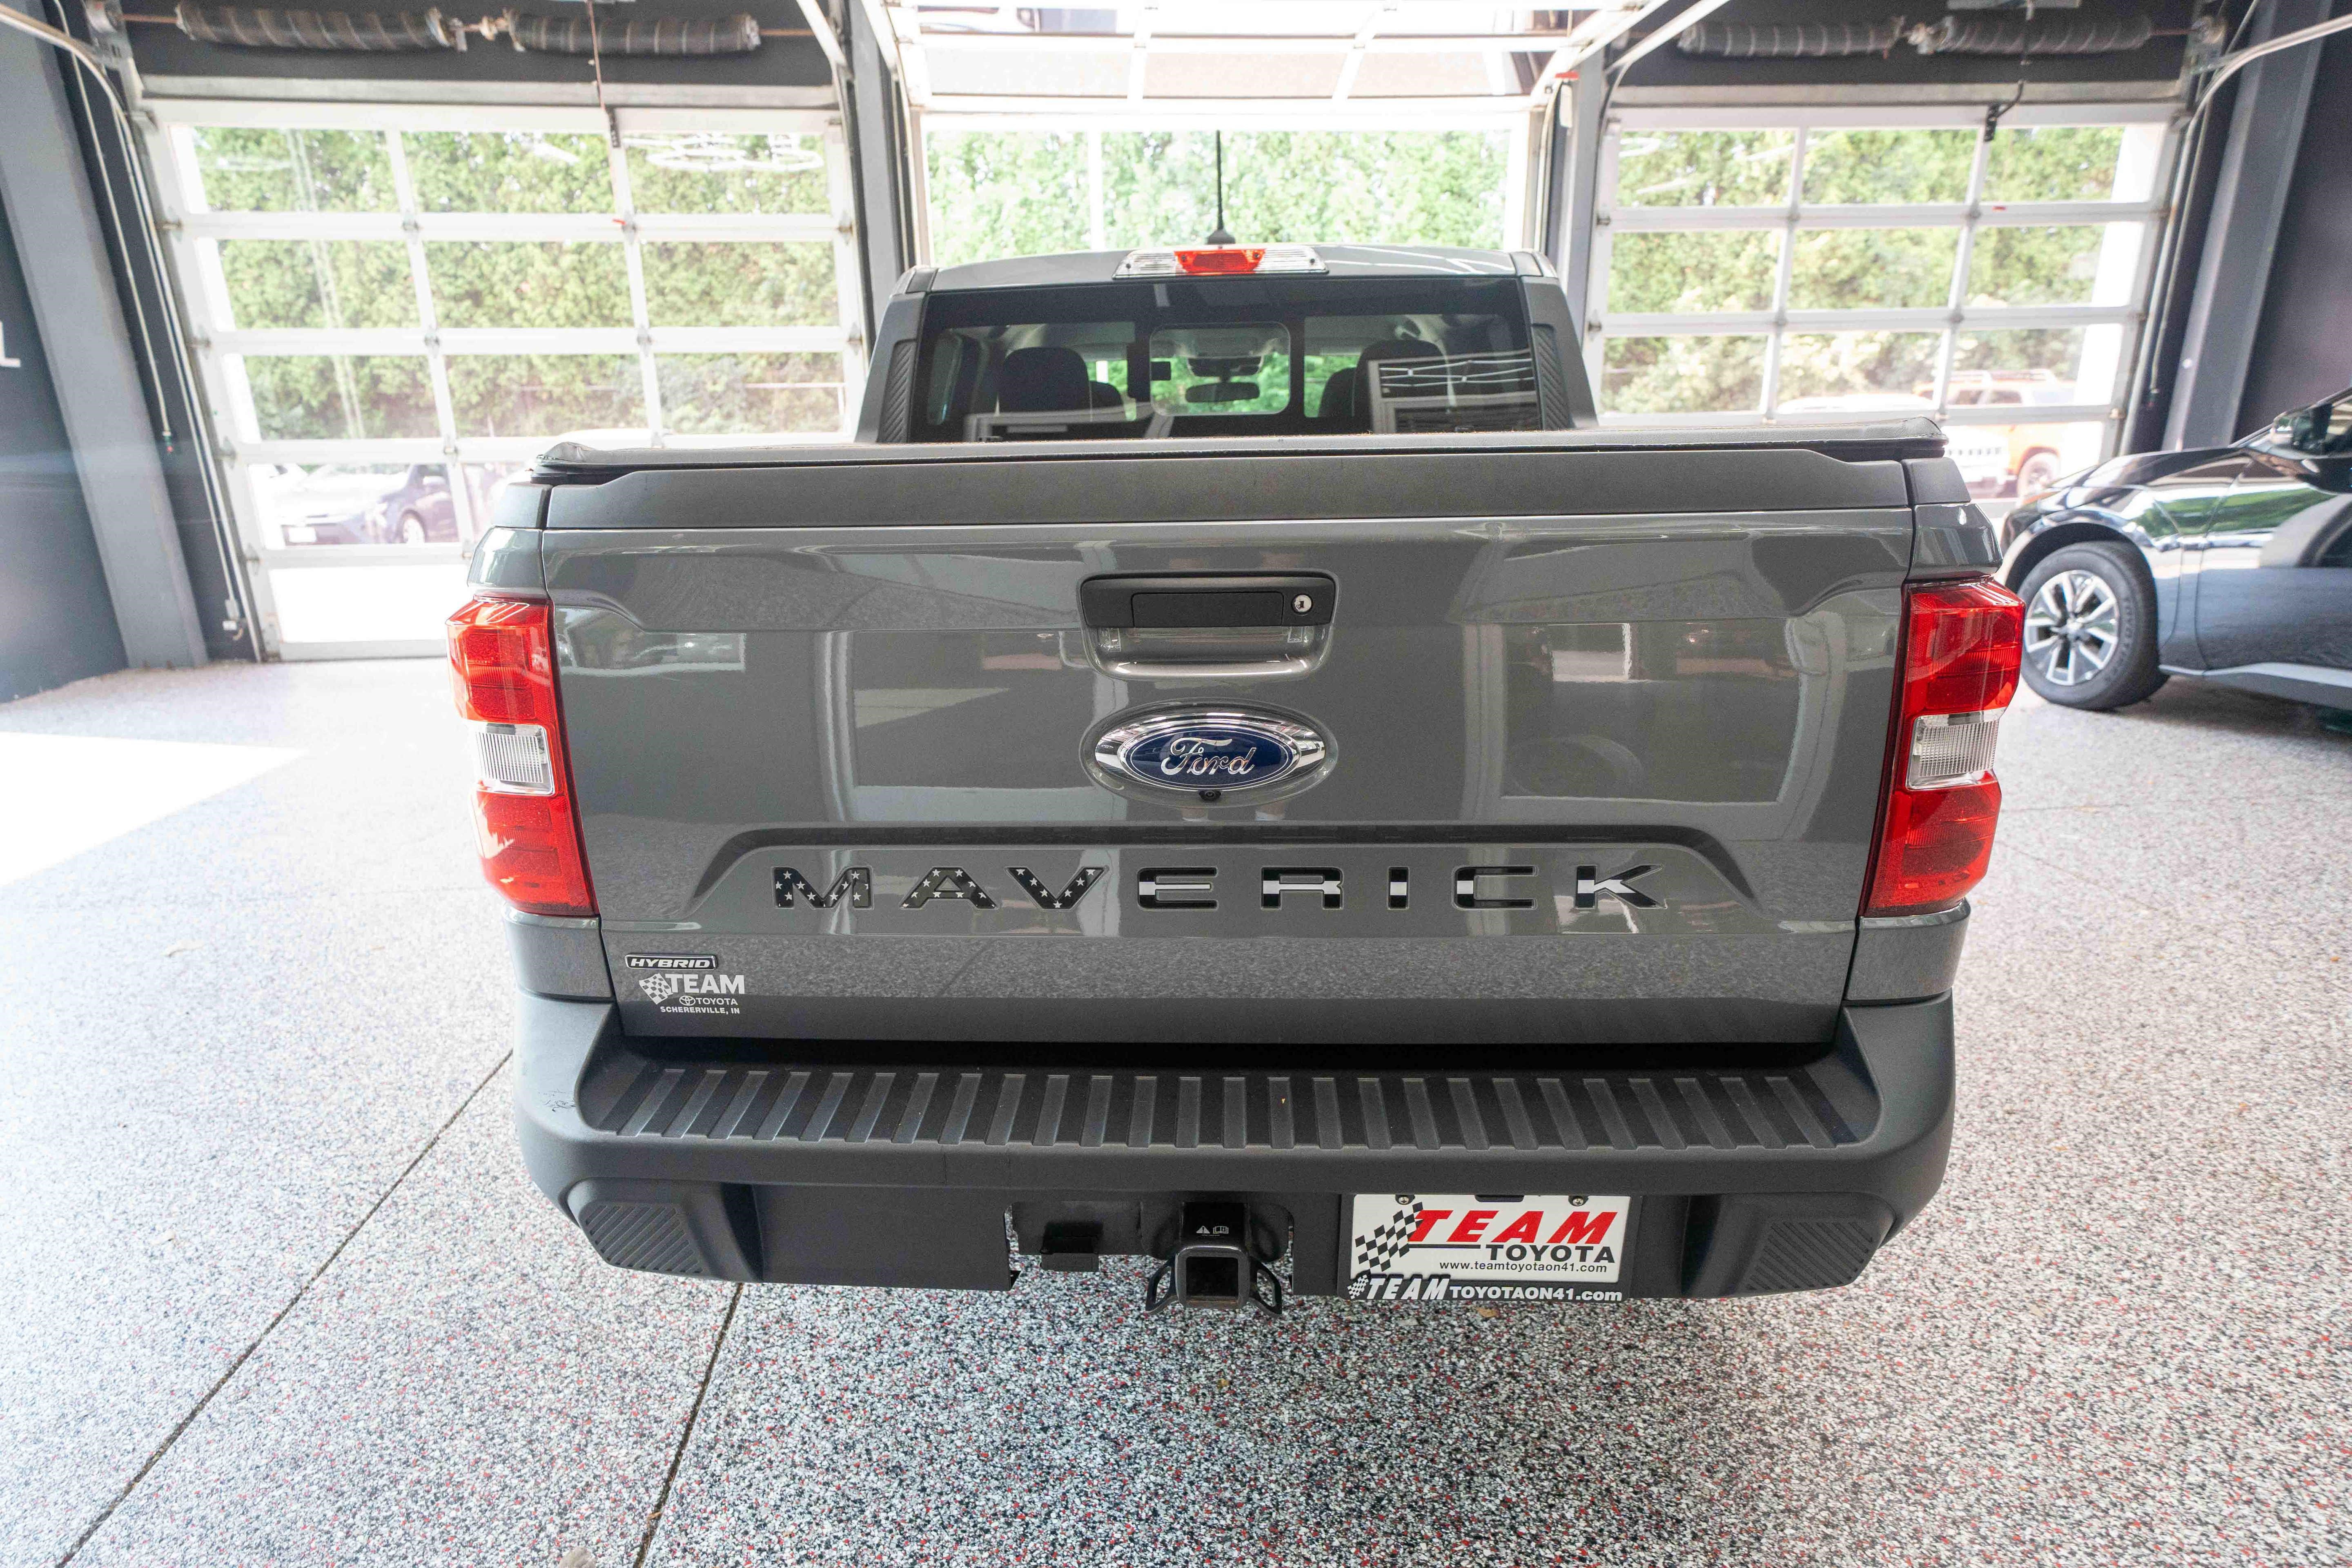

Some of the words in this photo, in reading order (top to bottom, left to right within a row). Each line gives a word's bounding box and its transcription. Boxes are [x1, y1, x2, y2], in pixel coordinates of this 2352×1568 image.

[1160, 737, 1257, 775] Ford
[771, 865, 1667, 911] MAVERICK
[630, 958, 710, 968] HYBRID
[665, 973, 745, 994] TEAM
[660, 1006, 728, 1015] SCHERERVILLE,
[1408, 1210, 1617, 1244] TEAM
[1486, 1244, 1615, 1263] TOYOTA
[1440, 1261, 1607, 1273] www.teamtoyotaon41.com
[1366, 1278, 1450, 1300] TEAM
[1450, 1286, 1623, 1302] TOYOTAON41.com
